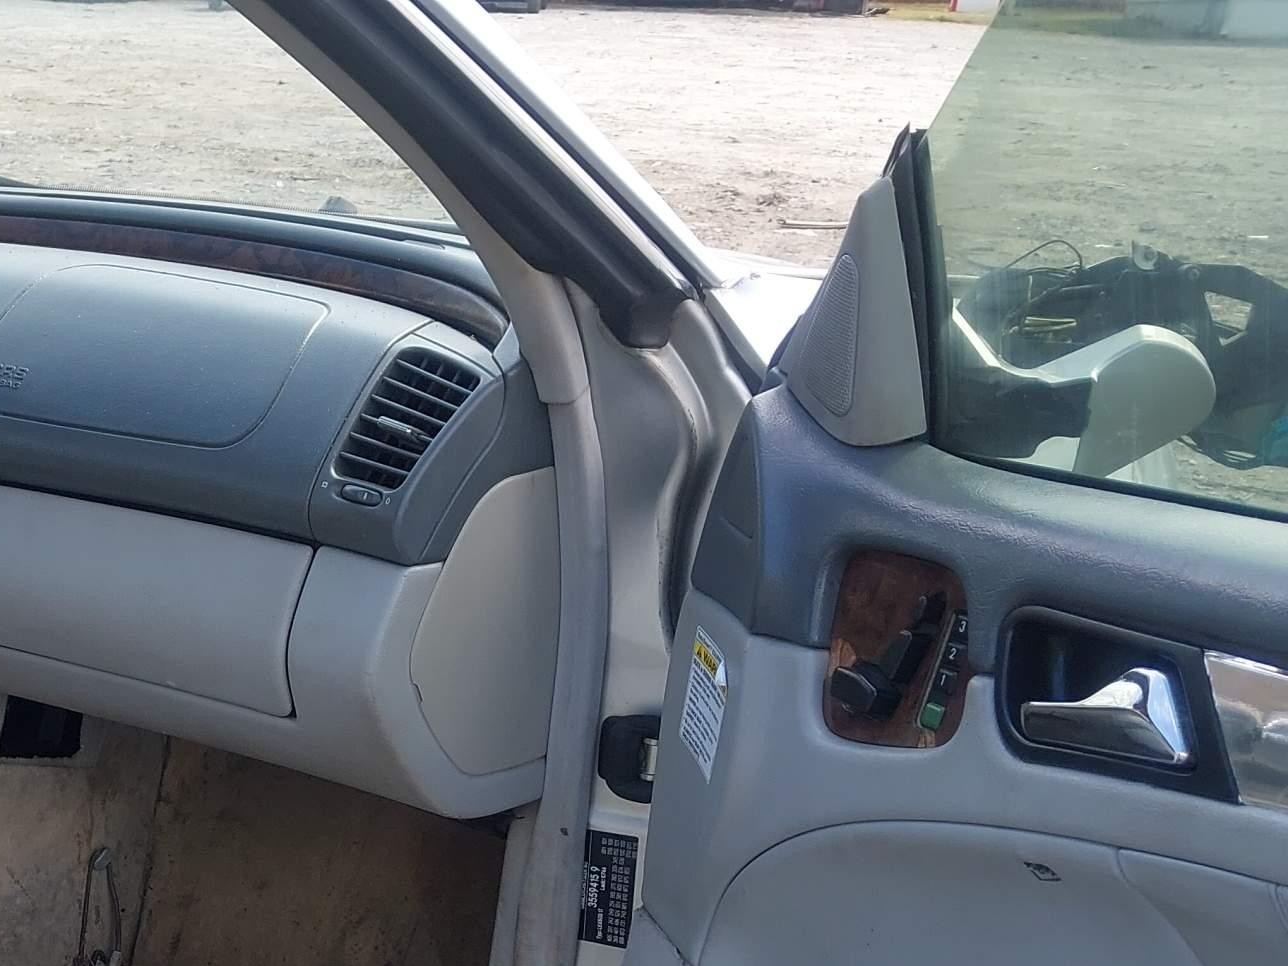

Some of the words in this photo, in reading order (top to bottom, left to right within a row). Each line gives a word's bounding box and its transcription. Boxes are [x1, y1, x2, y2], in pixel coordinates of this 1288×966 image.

[958, 620, 967, 633] 3
[948, 647, 957, 660] 2
[587, 873, 600, 908] 3559415
